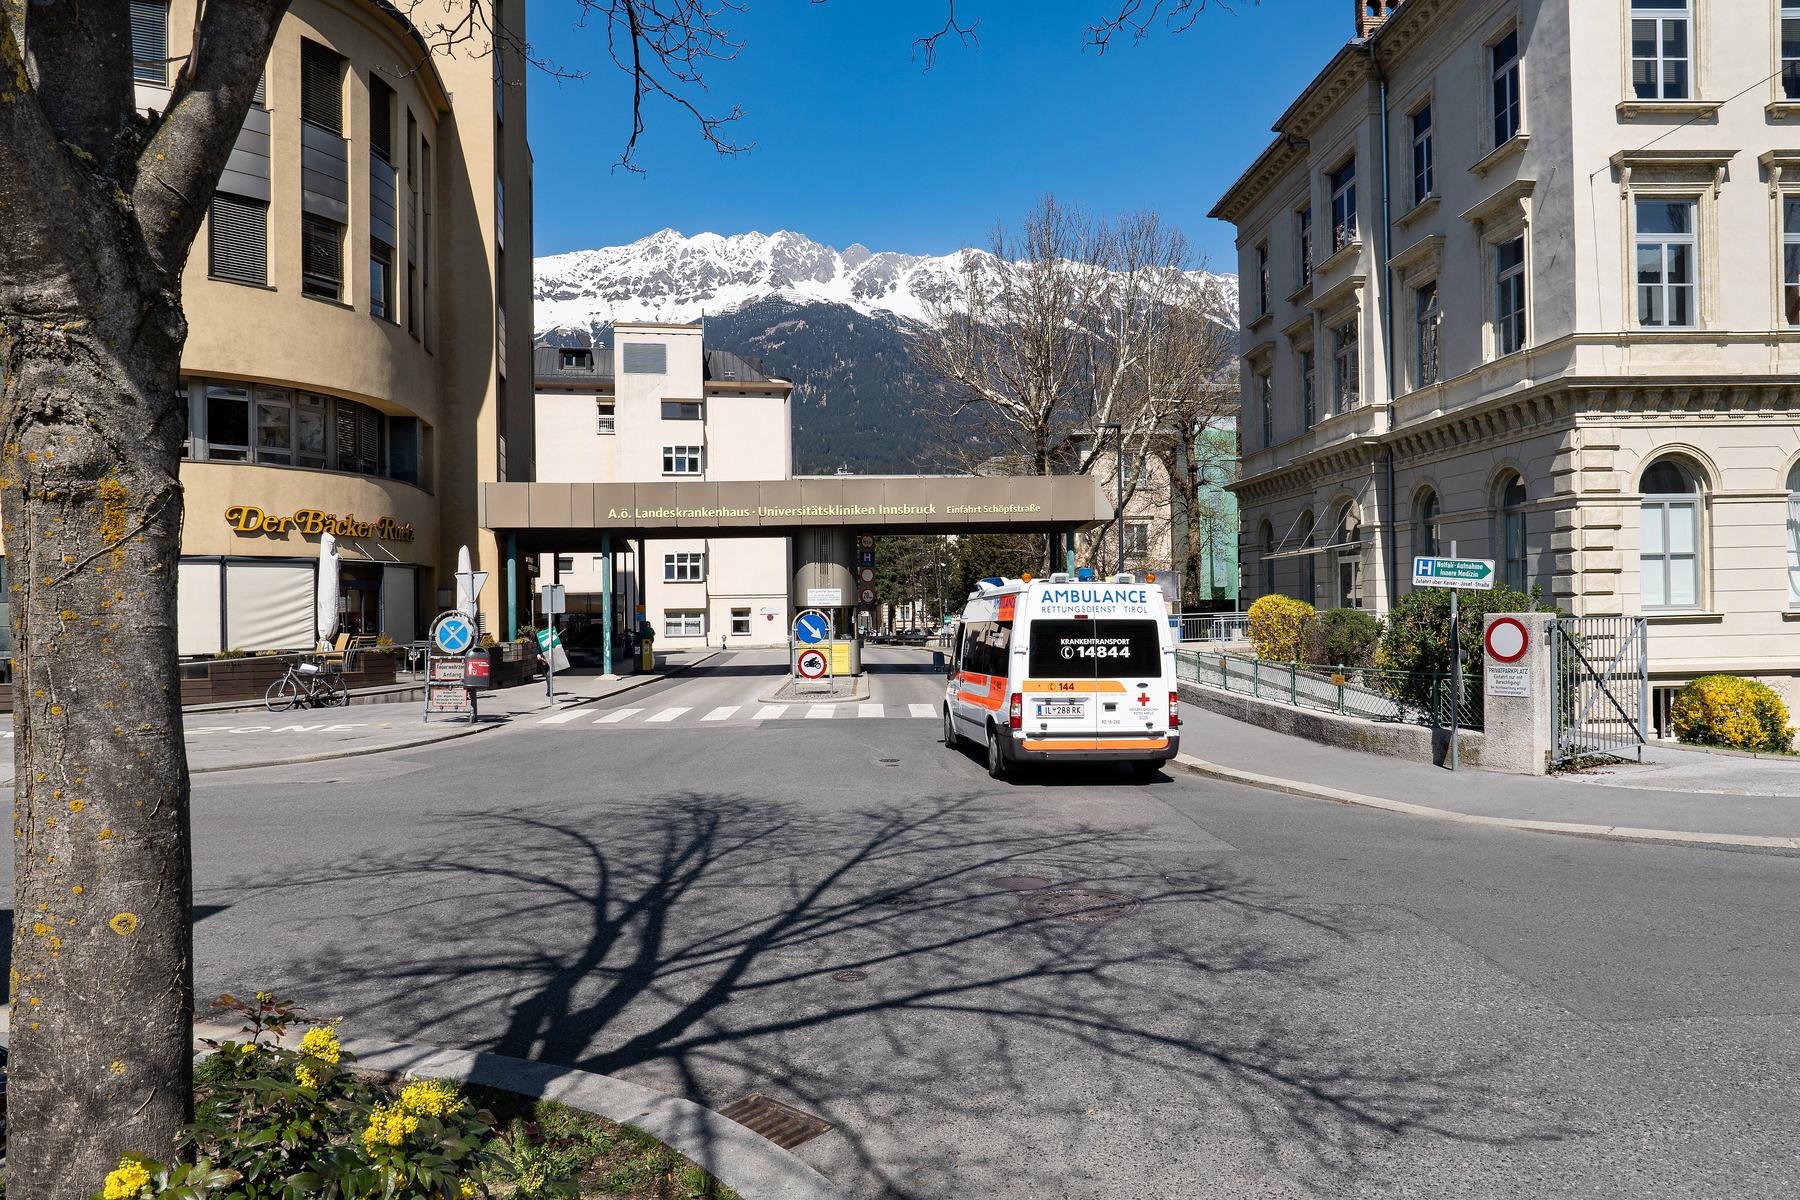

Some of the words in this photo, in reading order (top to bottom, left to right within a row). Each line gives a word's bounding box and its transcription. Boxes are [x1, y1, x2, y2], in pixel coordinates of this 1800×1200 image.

[608, 507, 632, 519] A.ö.
[635, 506, 750, 519] Landeskrankenhaus
[758, 505, 876, 517] Universitätskliniken
[879, 503, 937, 515] Innsbruck
[946, 505, 982, 514] Einfahrt
[983, 503, 1041, 515] Schöpfstraße
[224, 505, 293, 534] Der
[293, 508, 379, 538] Bäcker
[1440, 569, 1457, 577] Innere
[1457, 570, 1479, 578] Medizin
[1041, 590, 1147, 603] AMBULANCE
[1123, 606, 1148, 614] TIROL
[1076, 646, 1131, 658] 14844
[1488, 667, 1528, 675] PRIVATPARKPLATZ
[1059, 682, 1075, 690] 144
